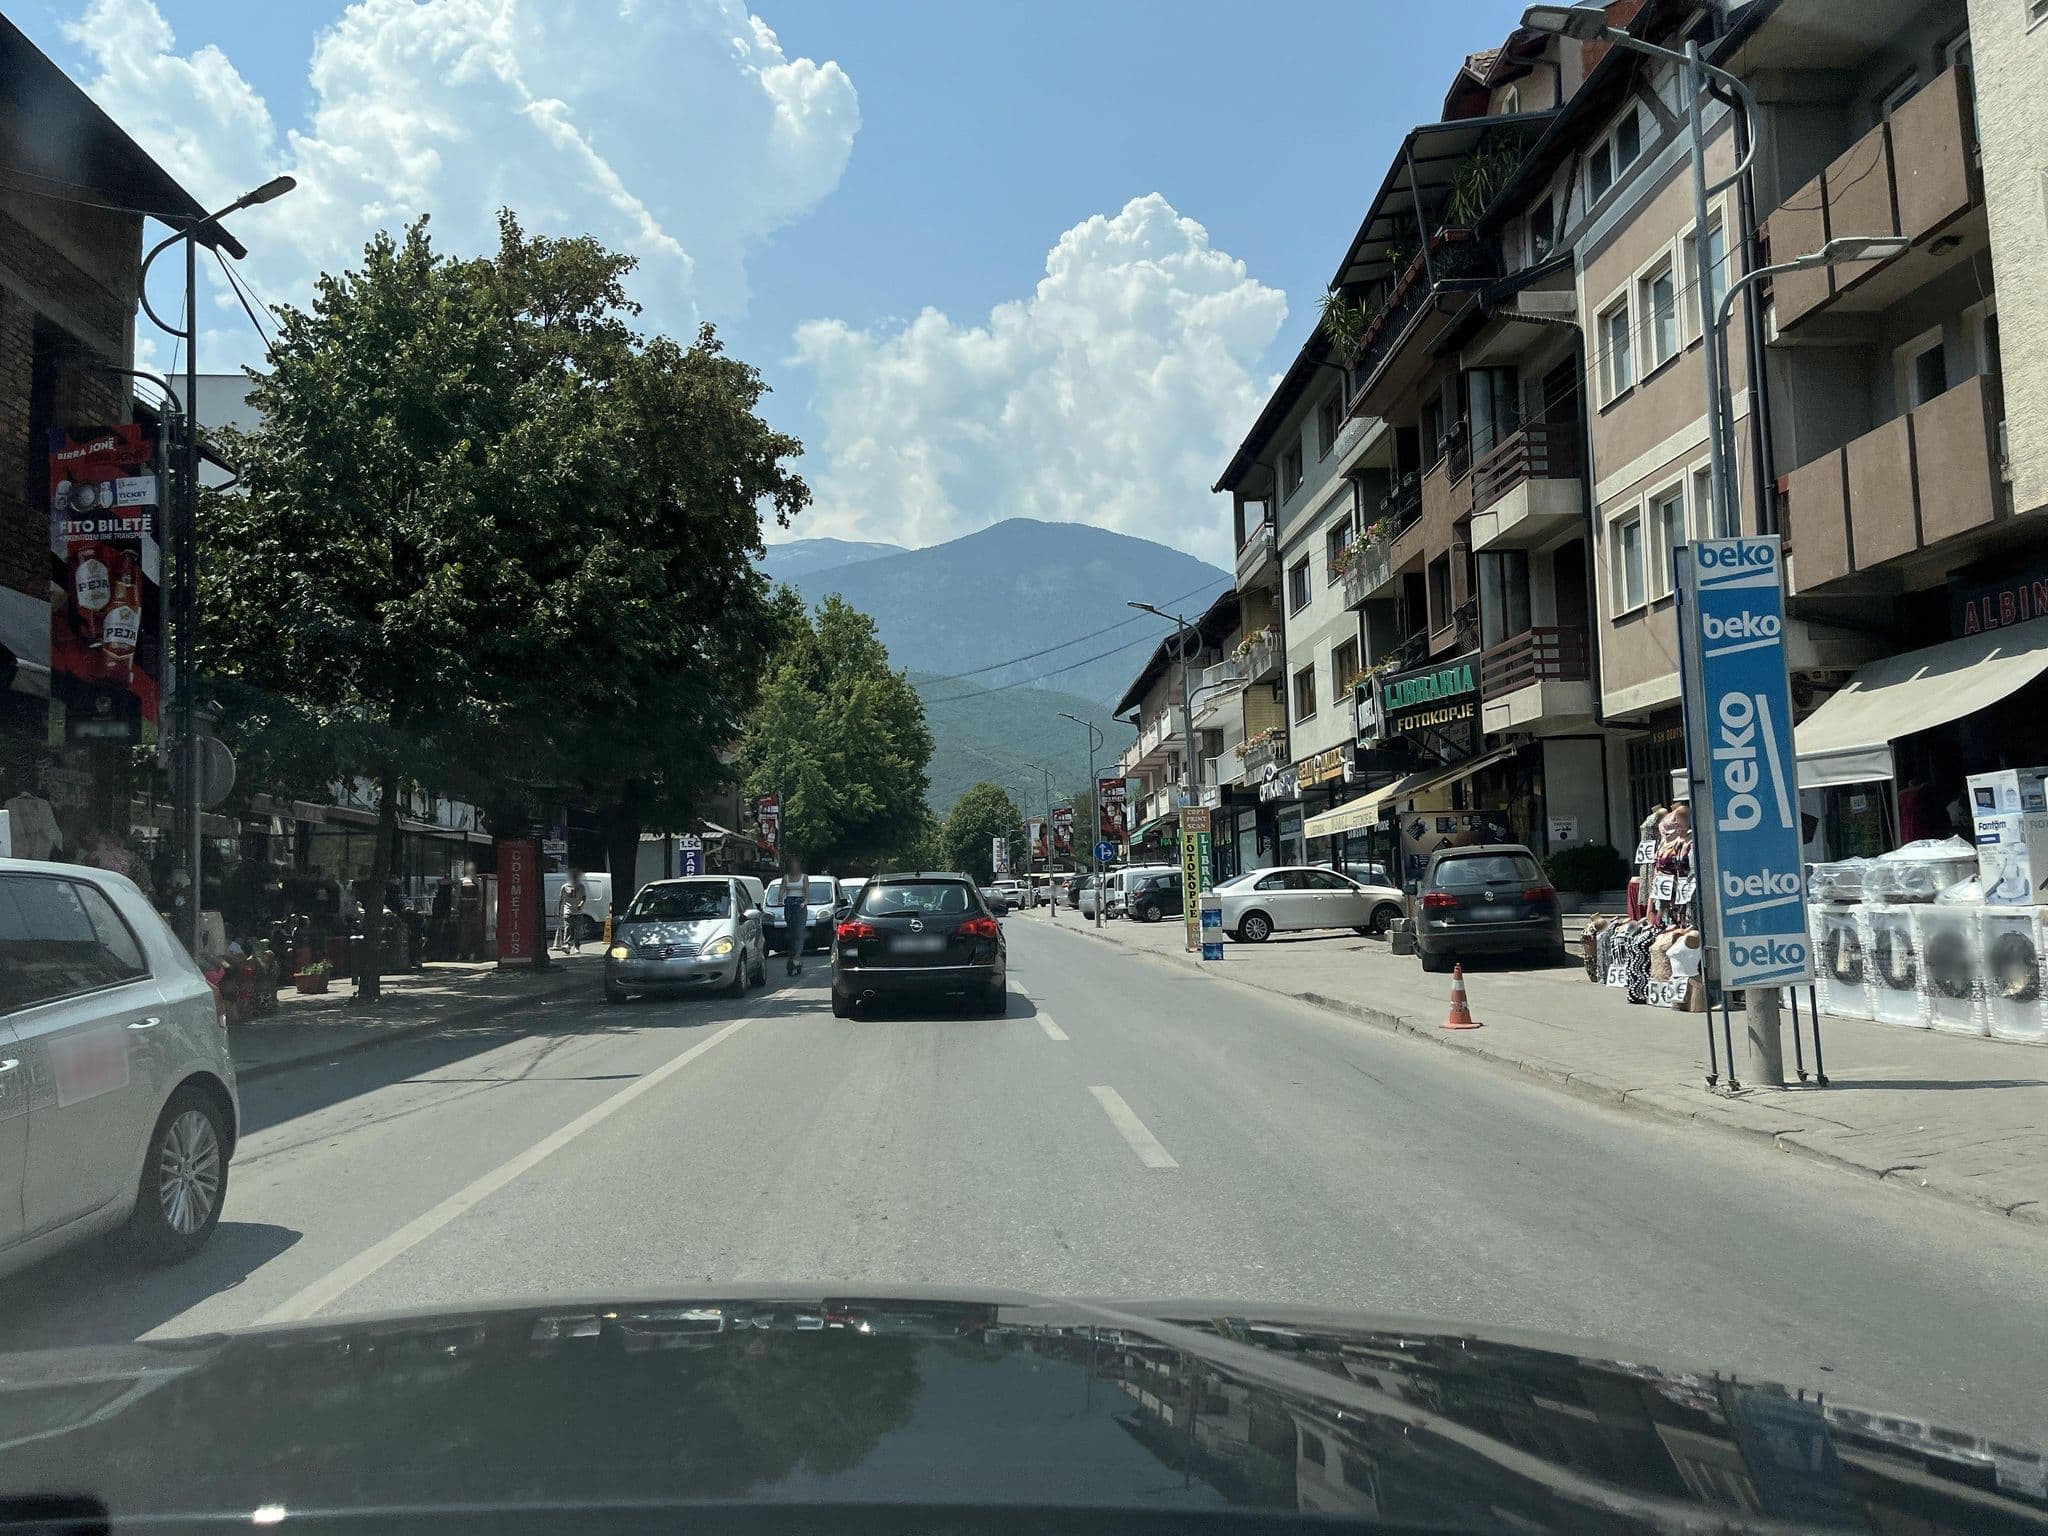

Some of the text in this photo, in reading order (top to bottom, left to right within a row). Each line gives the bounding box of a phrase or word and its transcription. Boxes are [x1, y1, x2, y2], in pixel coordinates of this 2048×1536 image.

[57, 448, 87, 461] BIRRA
[119, 490, 147, 499] TICKET
[98, 513, 152, 533] BILETË
[1698, 540, 1774, 568] beko
[79, 580, 109, 592] PEJA
[106, 627, 136, 641] PEJA
[1702, 611, 1781, 640] beko
[1384, 664, 1475, 710] LIBRARIA
[1397, 702, 1475, 732] FOTOKOPJE
[1713, 691, 1762, 832] beko
[1637, 845, 1653, 860] 5€
[1186, 834, 1197, 918] FOTOKOPJE
[1722, 868, 1799, 897] beko
[511, 850, 521, 954] COSMETICS
[1728, 938, 1806, 967] beko
[1609, 969, 1625, 984] 5€
